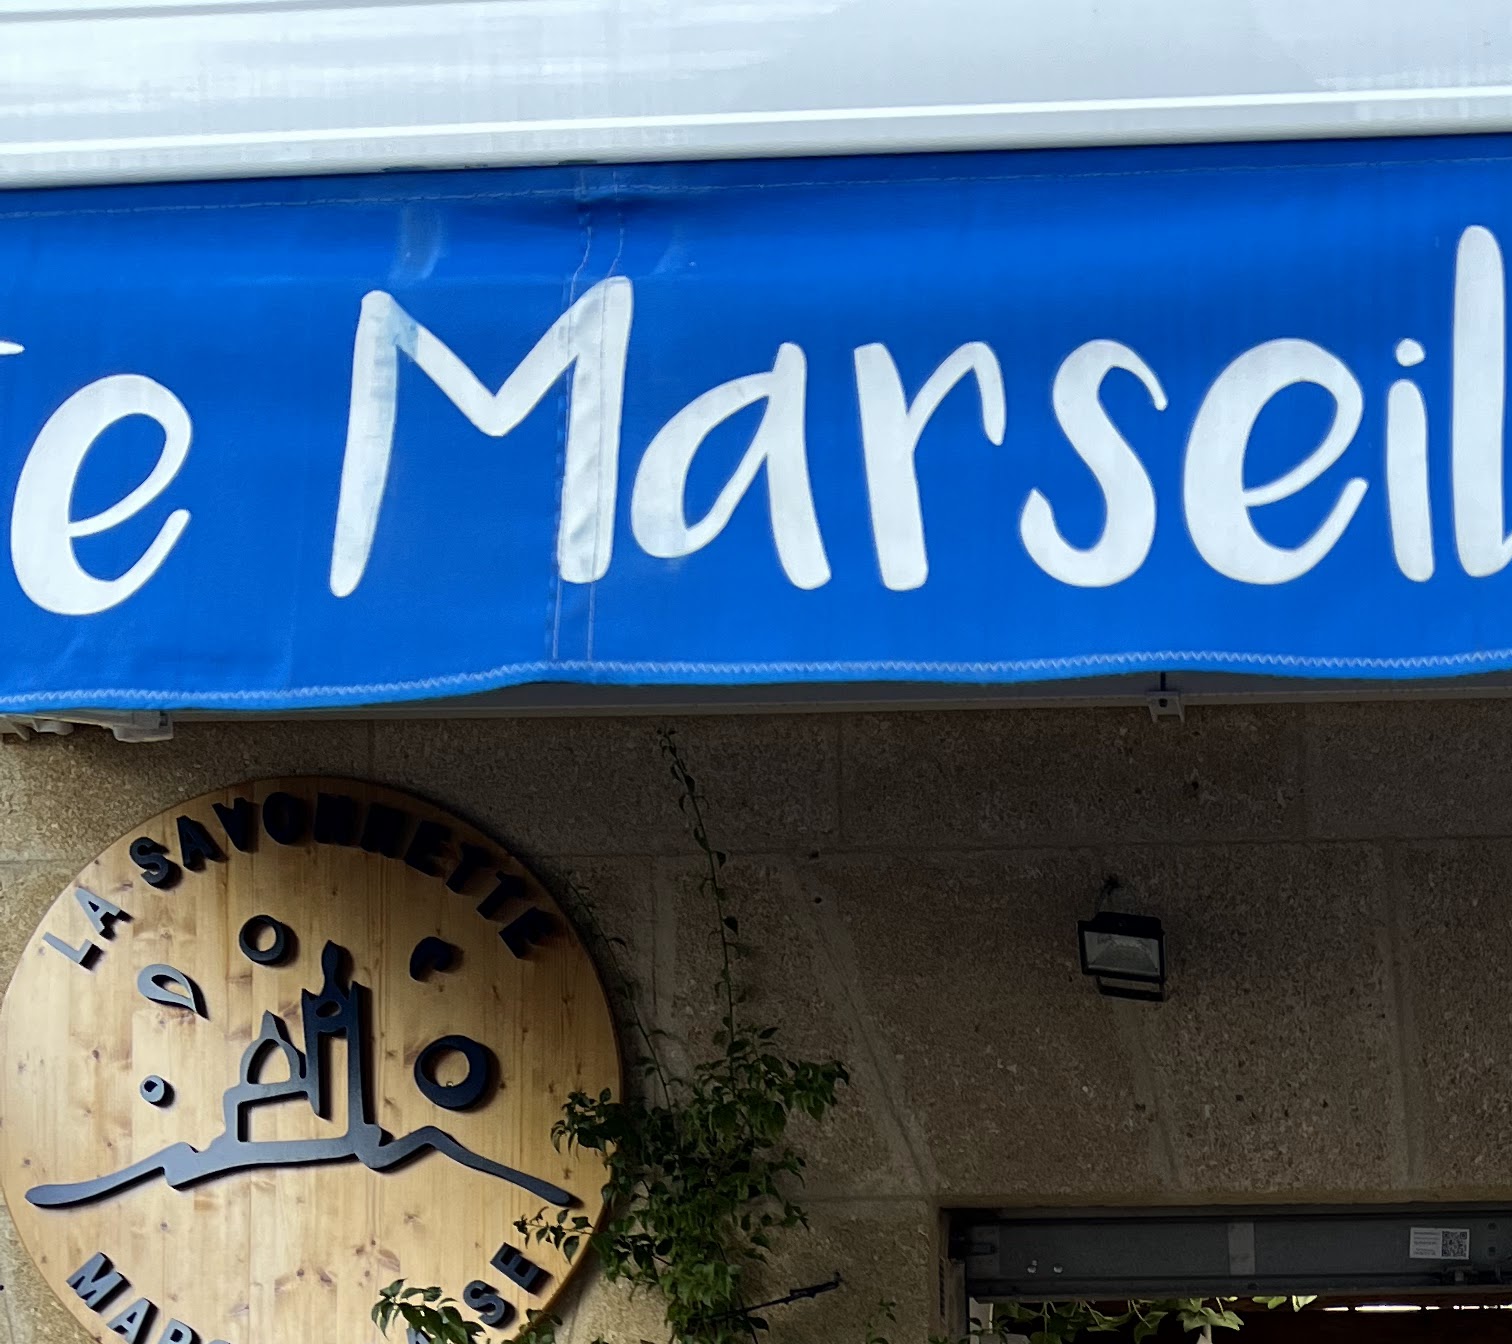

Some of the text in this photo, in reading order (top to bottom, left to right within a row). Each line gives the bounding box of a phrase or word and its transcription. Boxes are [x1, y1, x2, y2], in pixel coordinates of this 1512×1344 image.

[0, 340, 191, 617] e
[42, 791, 558, 970] LA SAVONNETTE
